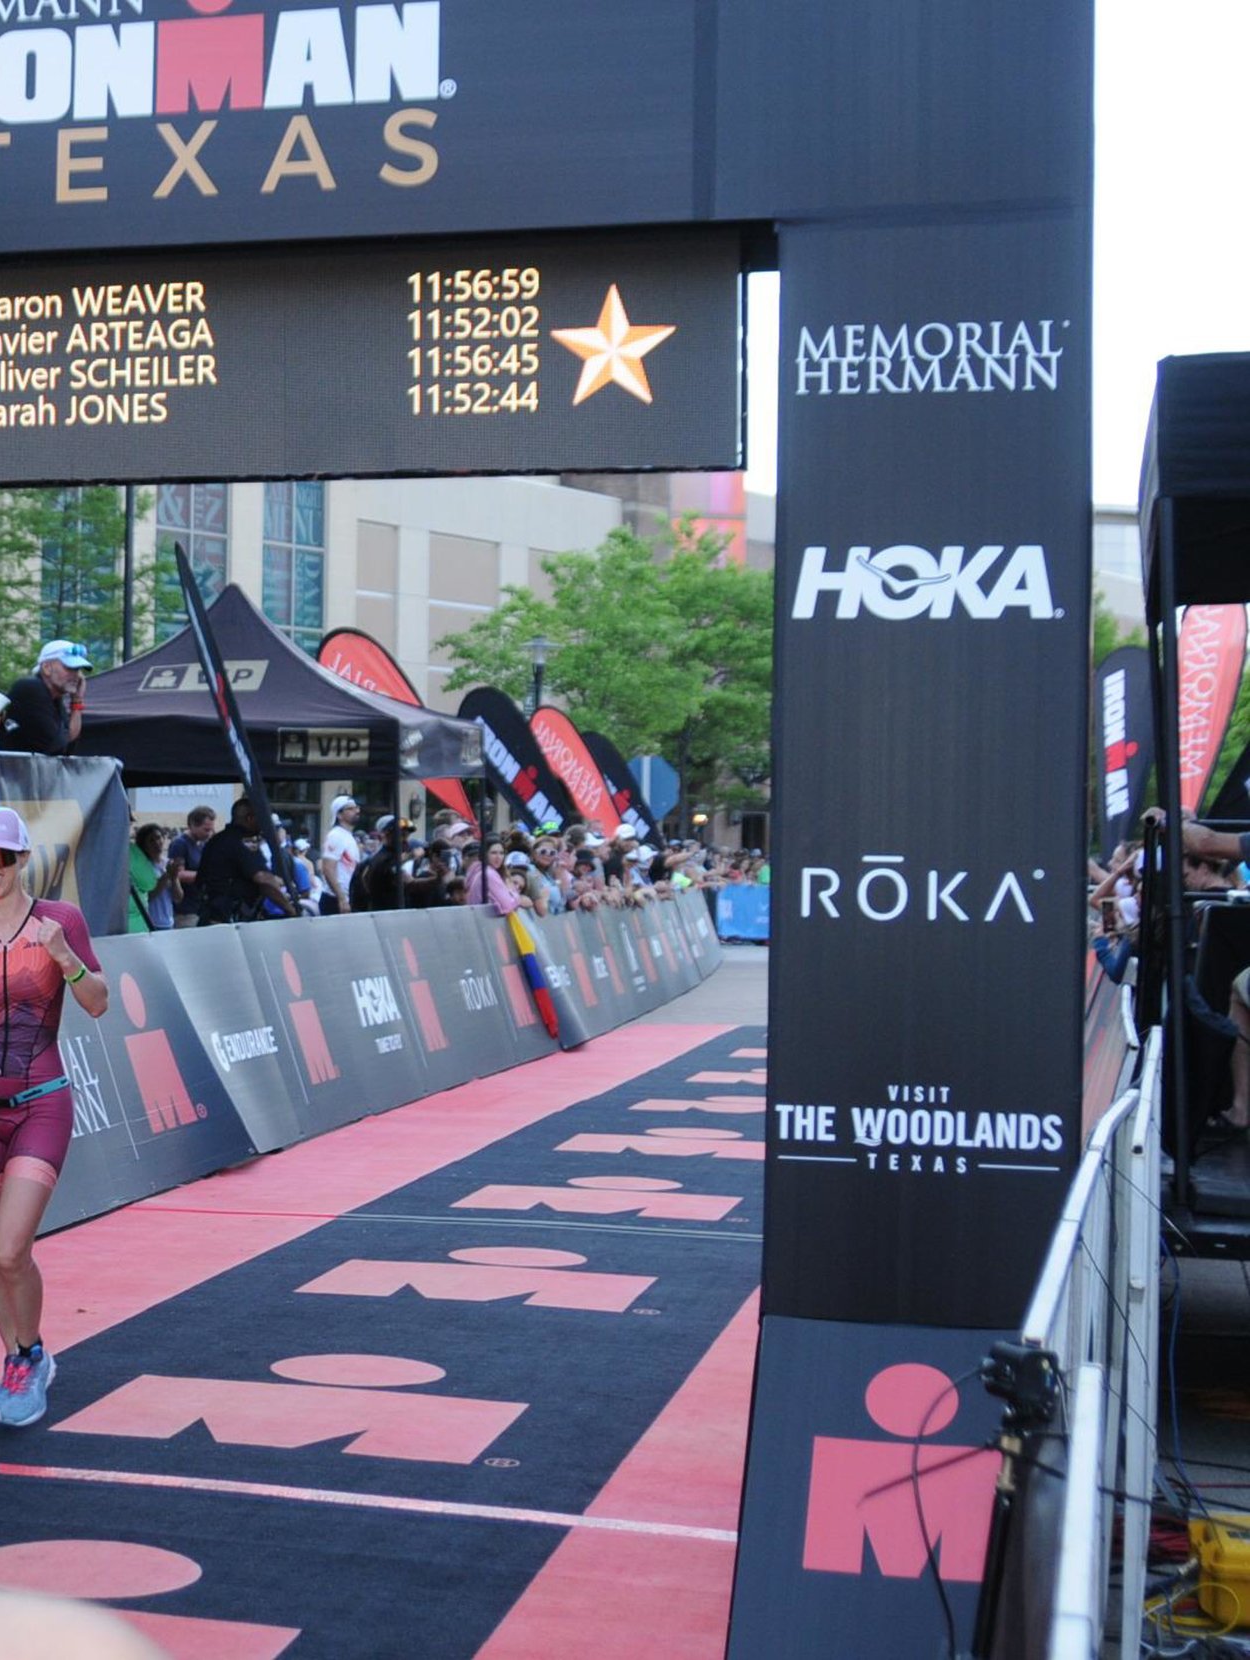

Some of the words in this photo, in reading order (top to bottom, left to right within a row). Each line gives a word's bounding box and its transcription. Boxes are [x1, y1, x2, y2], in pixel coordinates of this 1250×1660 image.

[72, 281, 205, 317] WEAVER
[407, 267, 540, 303] 11:56:59
[66, 318, 214, 354] ARTEAGA
[407, 305, 540, 340] 11:52:02
[797, 320, 1063, 362] MEMORIAL
[70, 354, 217, 389] SCHEILER
[407, 343, 539, 378] 11:56:45
[795, 355, 1058, 394] HERMANN
[66, 392, 168, 426] JONES
[407, 381, 539, 416] 11:52:44
[791, 545, 1054, 620] HOKA
[316, 737, 360, 757] VIP
[1103, 668, 1139, 822] IRONMAN
[352, 975, 401, 1027] HOKA
[888, 1085, 950, 1104] VISIT
[775, 1104, 836, 1142] THE
[851, 1107, 1063, 1151] WOODLANDS
[867, 1153, 967, 1174] TEXAS
